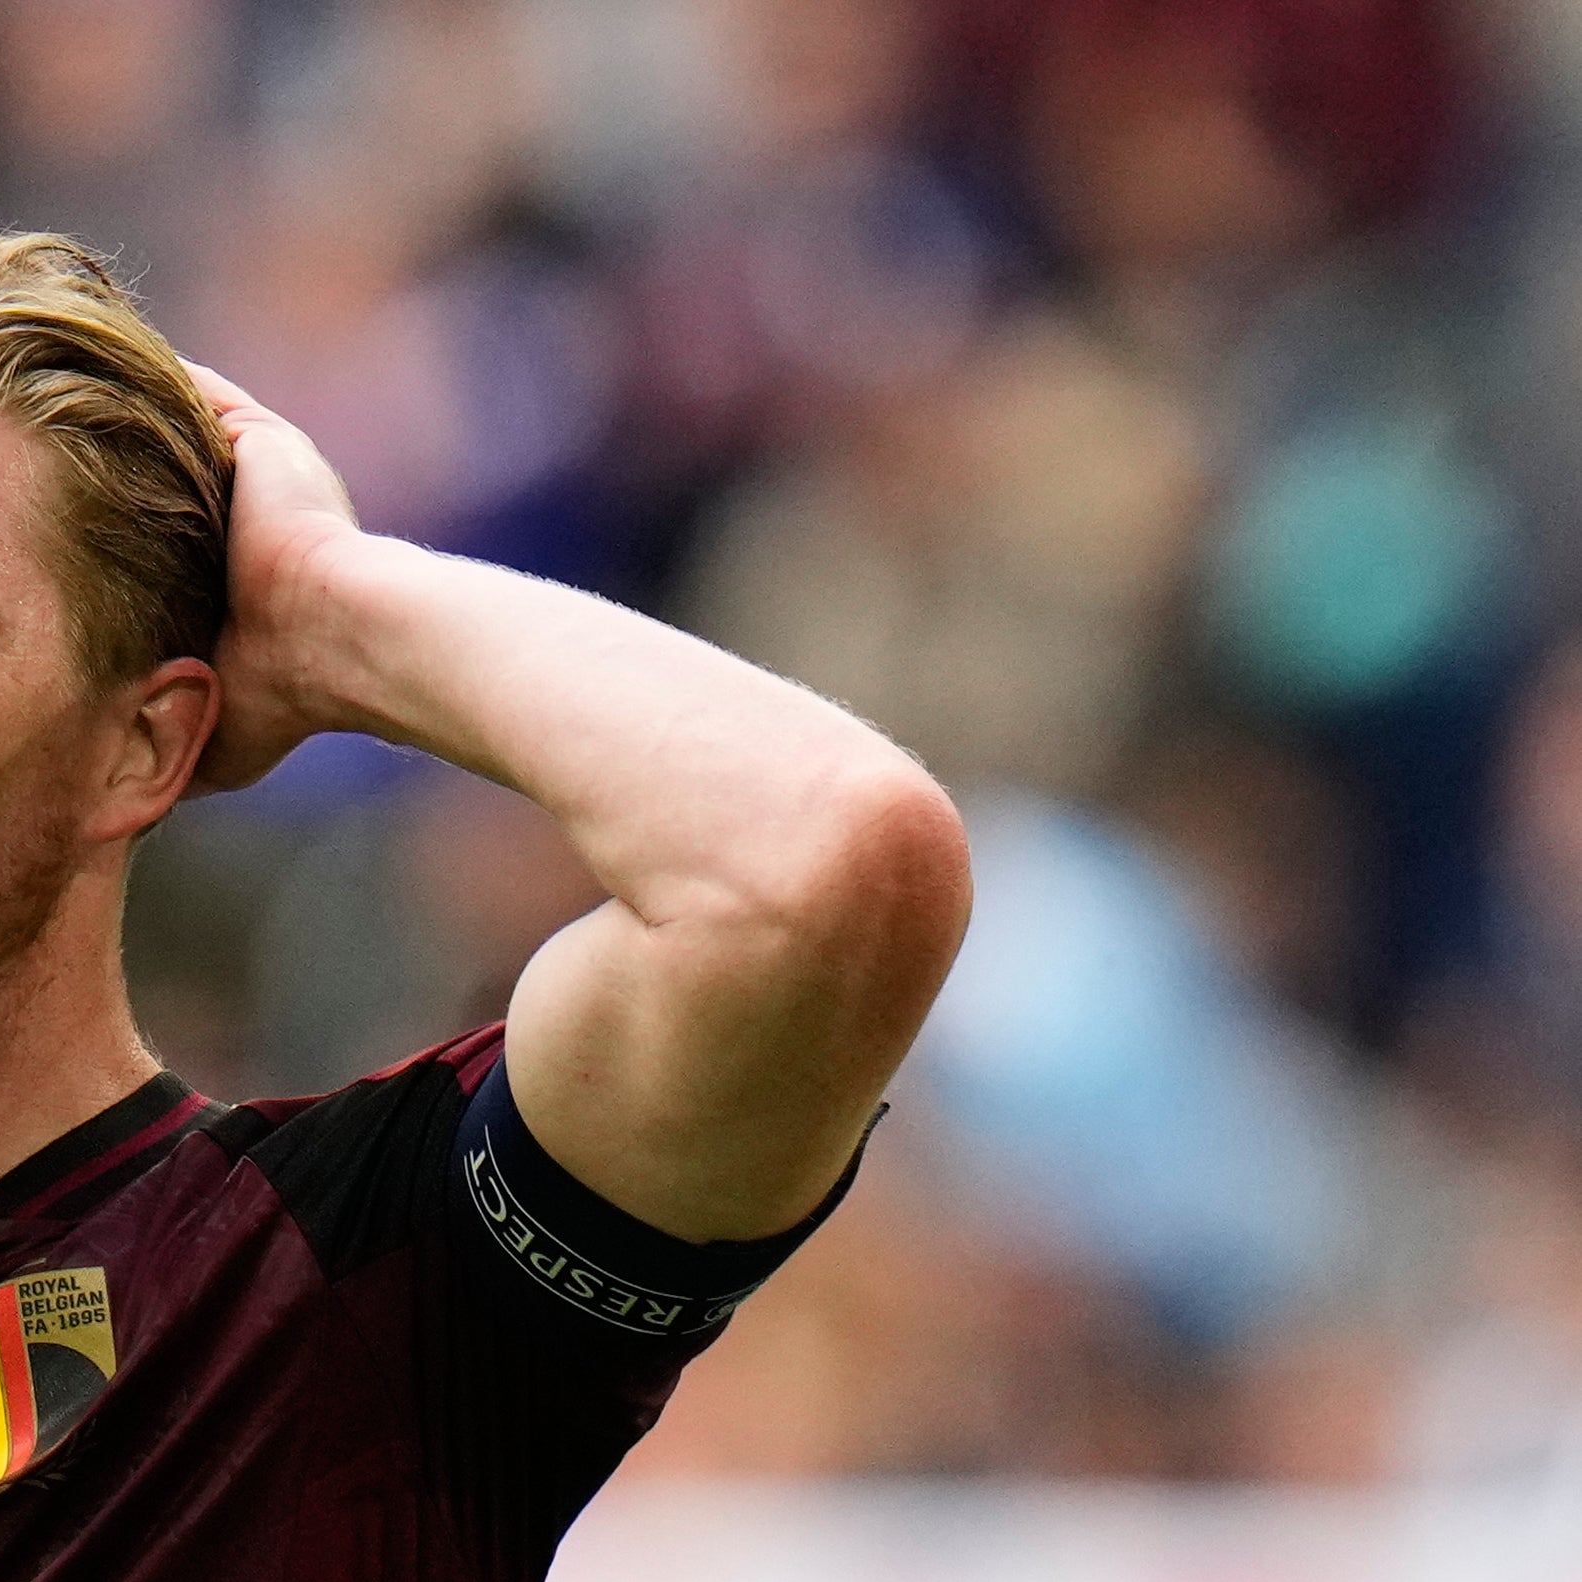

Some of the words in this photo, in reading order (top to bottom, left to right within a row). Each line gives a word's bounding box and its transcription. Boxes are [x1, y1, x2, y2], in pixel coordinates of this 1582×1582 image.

[469, 1149, 684, 1328] RESPECT
[19, 1276, 80, 1298] ROYAL
[22, 1291, 103, 1316] BELGIAN
